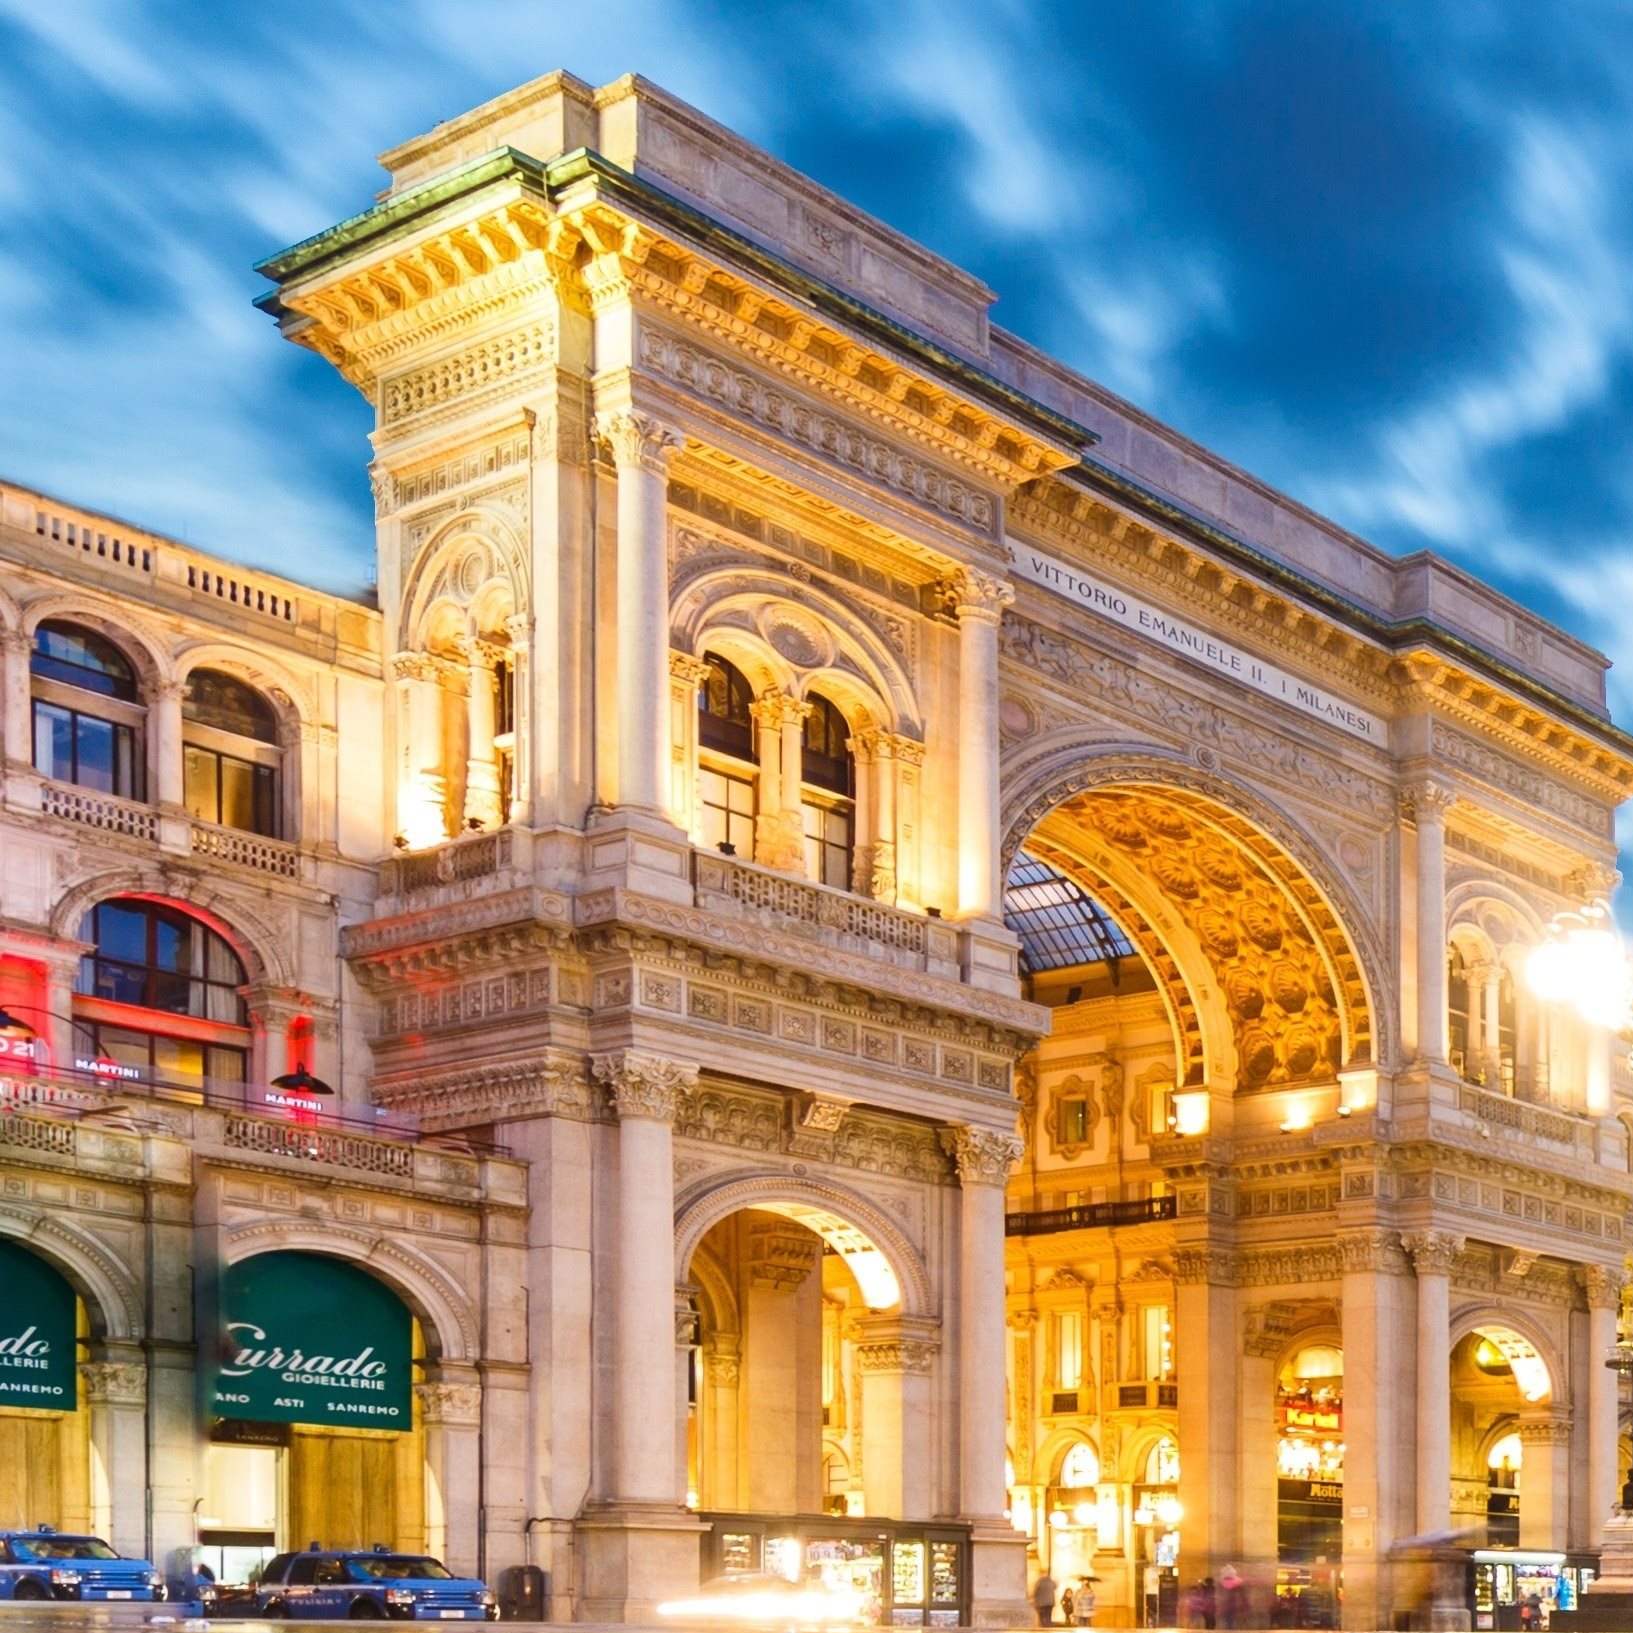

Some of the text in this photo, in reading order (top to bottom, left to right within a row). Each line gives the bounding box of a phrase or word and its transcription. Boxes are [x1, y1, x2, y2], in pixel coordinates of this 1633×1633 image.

[1031, 557, 1127, 616] VITTORIO
[1138, 610, 1242, 672] EMANUELE
[1281, 679, 1287, 694] I
[1296, 687, 1372, 735] MILANESI
[13, 1041, 35, 1058] 21
[75, 1058, 139, 1079] MARTINI
[265, 1093, 322, 1111] MARTINI
[281, 1371, 385, 1391] GIOIELLERIE
[273, 1397, 304, 1409] ASTI
[326, 1402, 400, 1416] SANREMO
